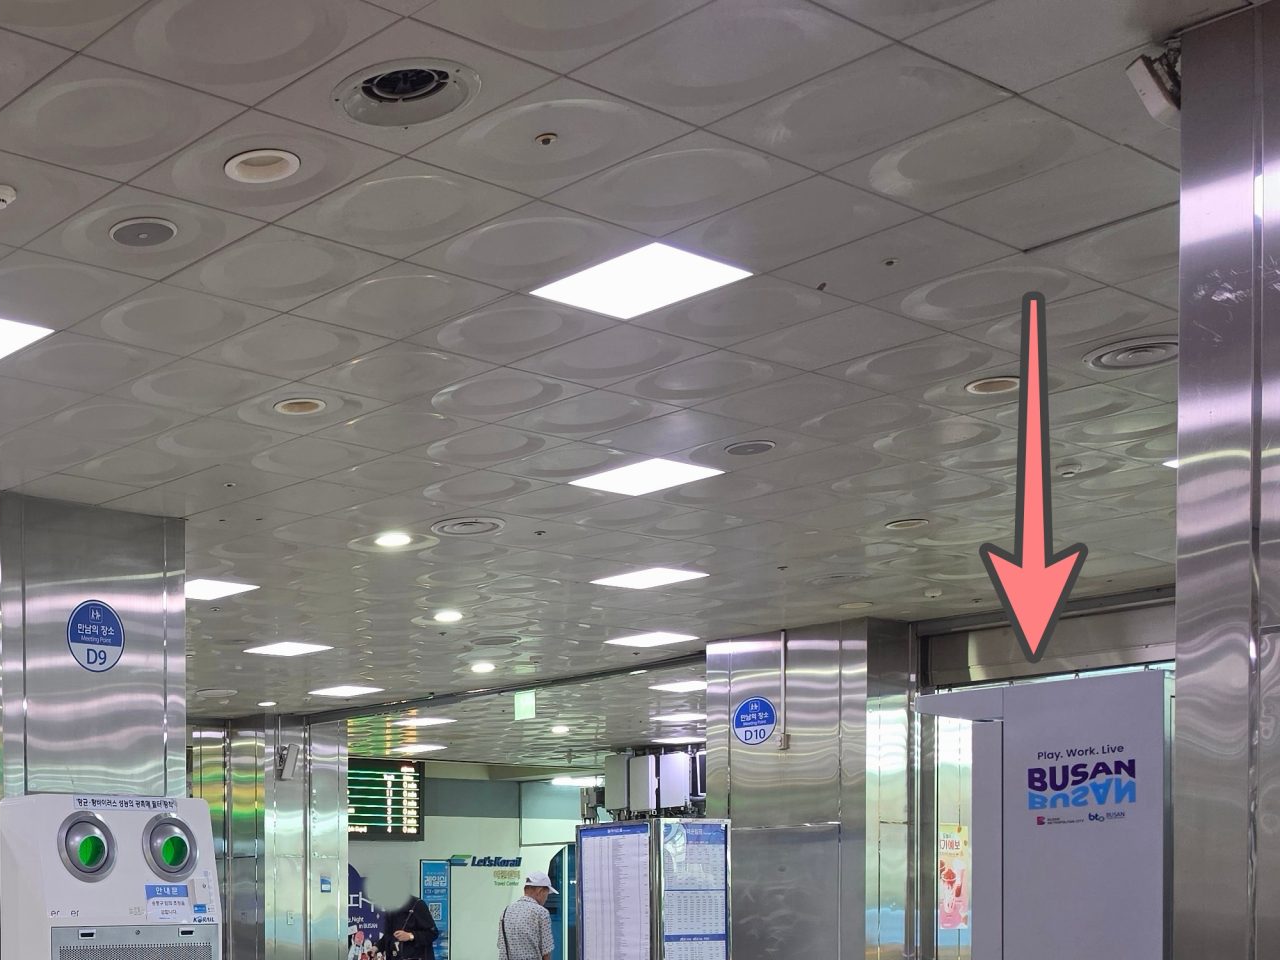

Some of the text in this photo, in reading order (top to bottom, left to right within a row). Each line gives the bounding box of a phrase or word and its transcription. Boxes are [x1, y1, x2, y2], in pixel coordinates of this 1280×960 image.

[77, 623, 115, 636] 만남의 장소
[80, 635, 99, 644] Meeting
[86, 648, 107, 665] D9
[741, 712, 769, 722] 만남의 장소
[744, 729, 766, 741] D10
[1037, 744, 1124, 761] Play. Work. Live
[1028, 759, 1136, 792] BUSAN
